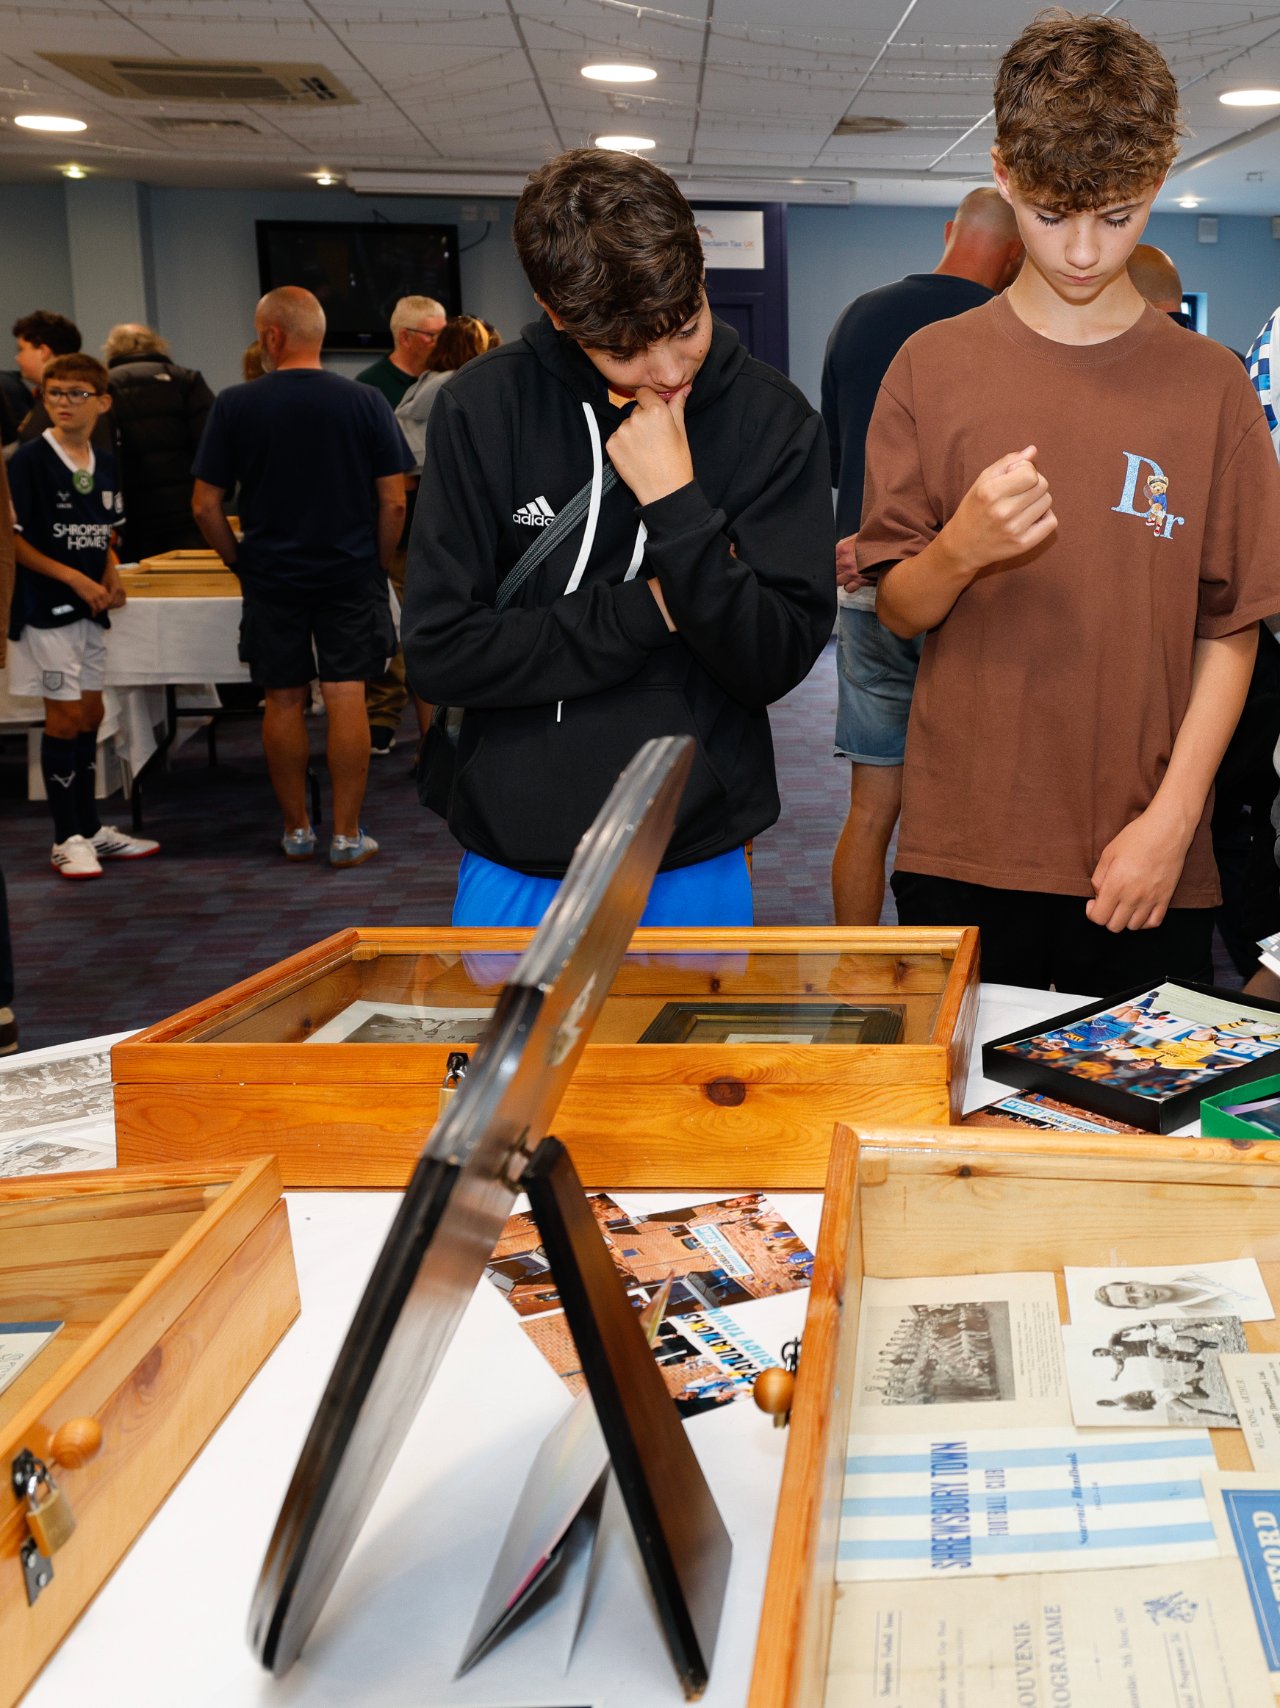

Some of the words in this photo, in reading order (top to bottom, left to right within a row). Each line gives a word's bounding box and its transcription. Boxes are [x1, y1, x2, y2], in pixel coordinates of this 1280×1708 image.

[512, 513, 556, 527] adida
[67, 535, 108, 551] HOMES
[930, 1441, 968, 1478] TOWN
[984, 1467, 1005, 1488] CLUB
[1067, 1452, 1082, 1499] Handbook
[930, 1480, 973, 1570] SHREWSBURY
[986, 1495, 1008, 1537] FOOTBALL
[1013, 1620, 1038, 1708] OUVENIR
